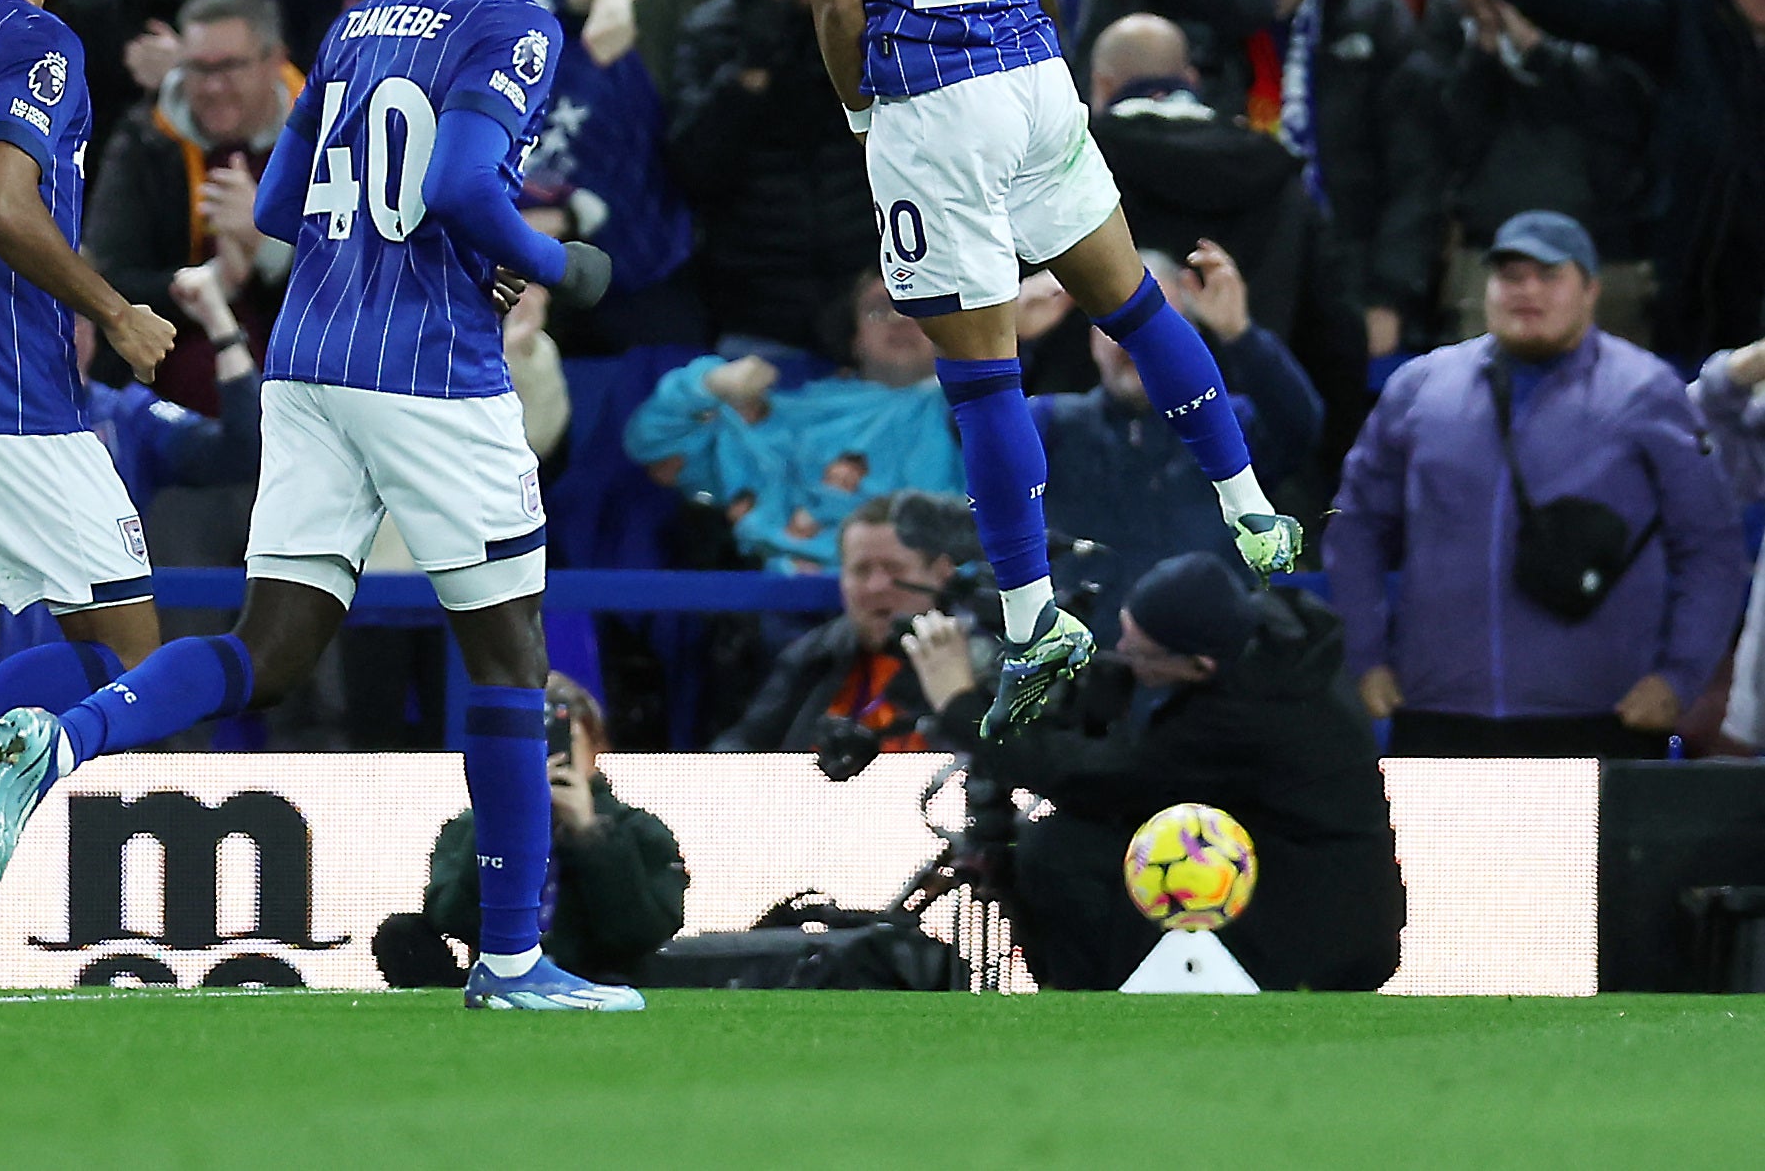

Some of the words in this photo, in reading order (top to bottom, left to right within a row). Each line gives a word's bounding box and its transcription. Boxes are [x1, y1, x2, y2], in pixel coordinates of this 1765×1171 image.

[303, 76, 438, 242] 40
[1165, 386, 1217, 418] ITFC
[476, 854, 503, 869] FC
